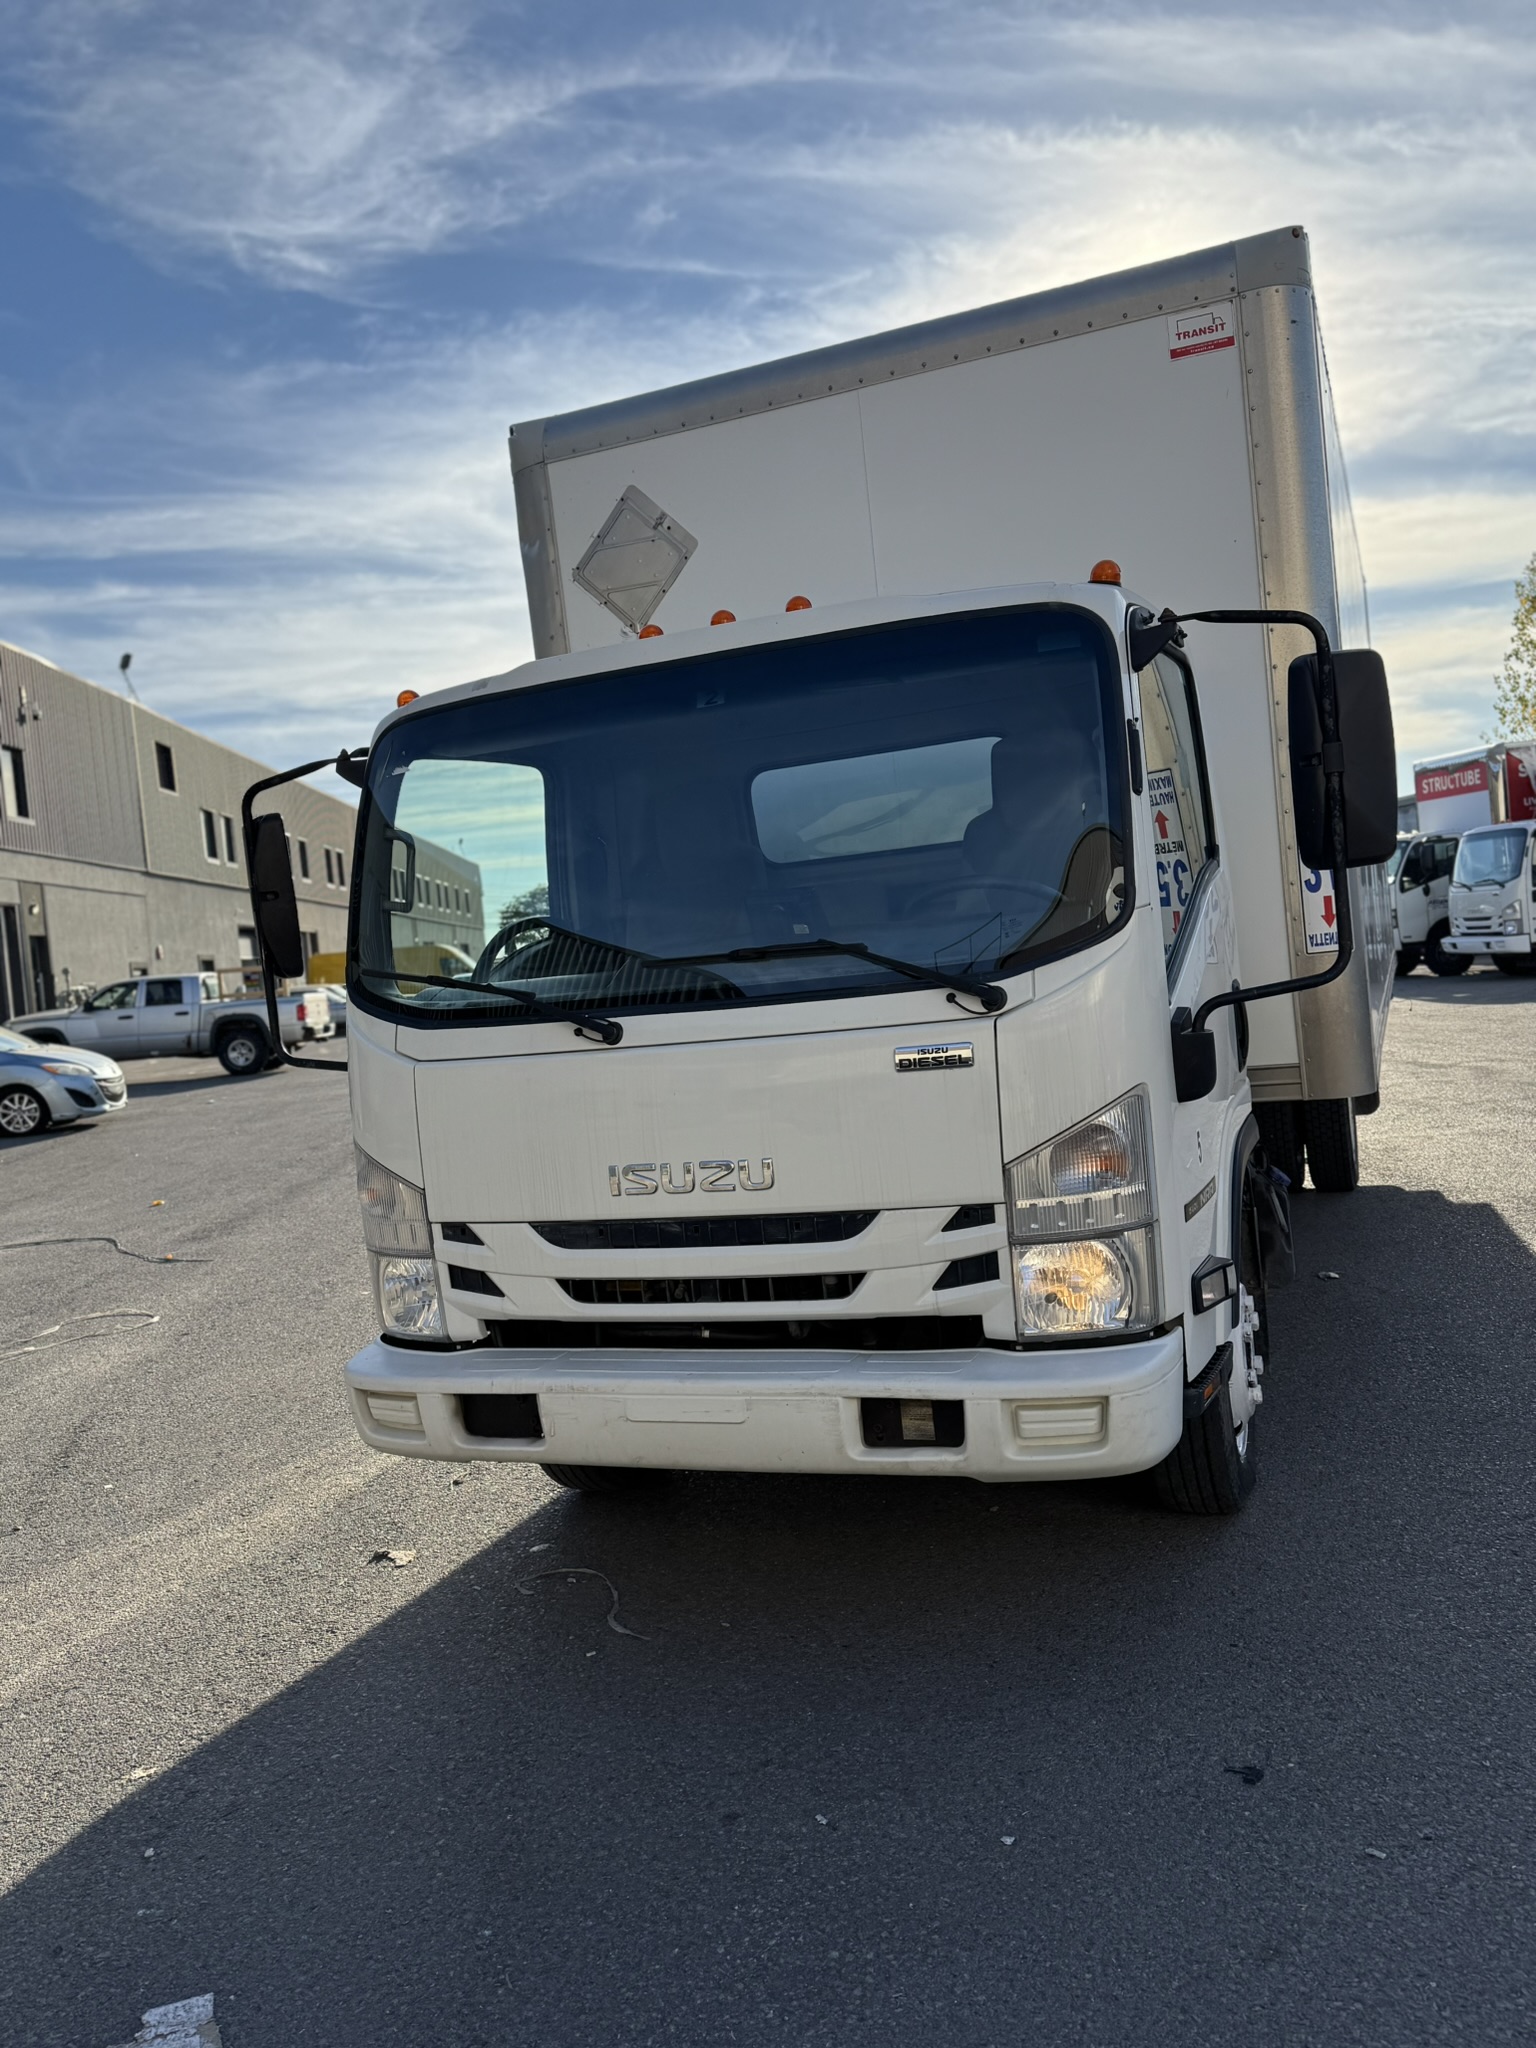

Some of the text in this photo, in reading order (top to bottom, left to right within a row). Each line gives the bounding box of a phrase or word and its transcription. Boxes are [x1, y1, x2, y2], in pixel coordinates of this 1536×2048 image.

[1175, 322, 1226, 341] TRANSIT
[1422, 768, 1481, 795] STRUCTUBE
[1150, 790, 1175, 807] HAUTE
[1155, 840, 1184, 856] MÈTRE
[1157, 859, 1190, 907] 3.5
[917, 1046, 948, 1056] ISUZU
[898, 1054, 972, 1069] DIESEL
[608, 1157, 776, 1197] ISUZU
